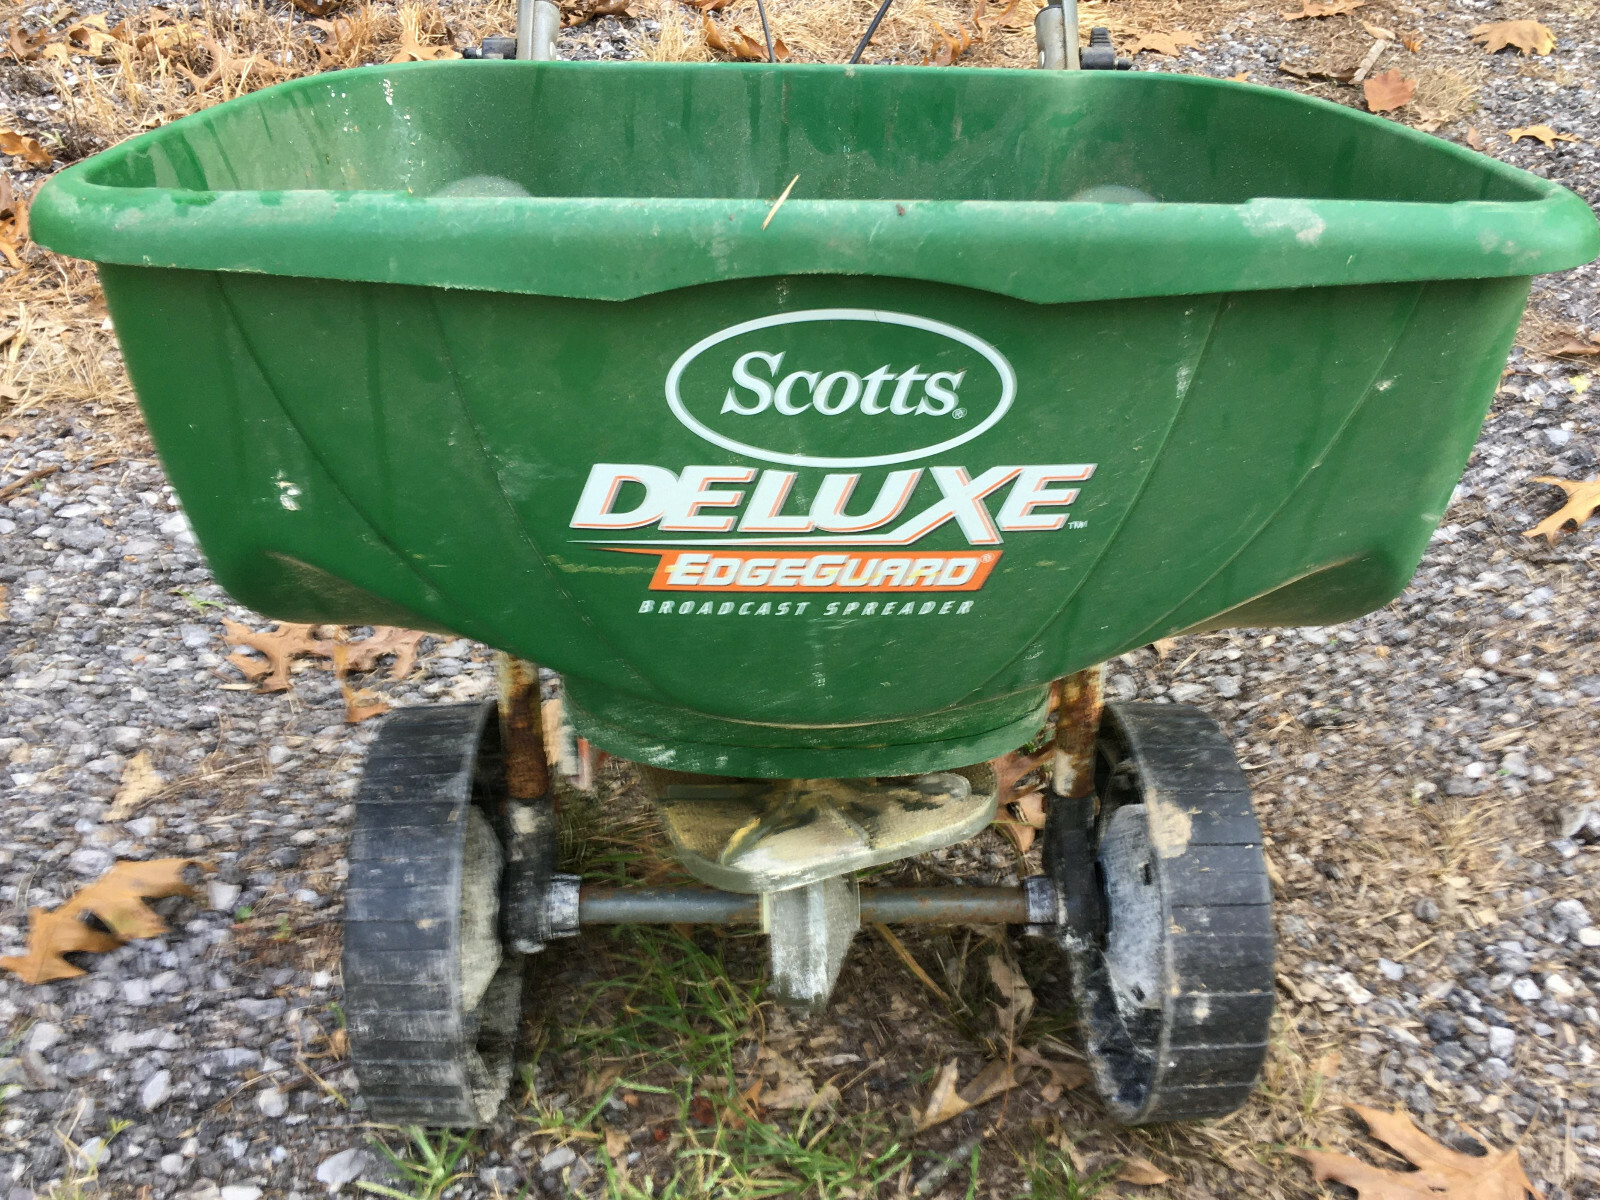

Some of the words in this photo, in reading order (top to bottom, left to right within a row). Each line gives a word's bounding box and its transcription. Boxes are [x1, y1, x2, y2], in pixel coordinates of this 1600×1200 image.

[720, 350, 967, 416] Scotts
[569, 463, 1098, 545] DELUXE
[665, 554, 981, 588] EDGEGUARD
[638, 599, 812, 616] BROADCAST
[823, 600, 976, 616] SPREADER
